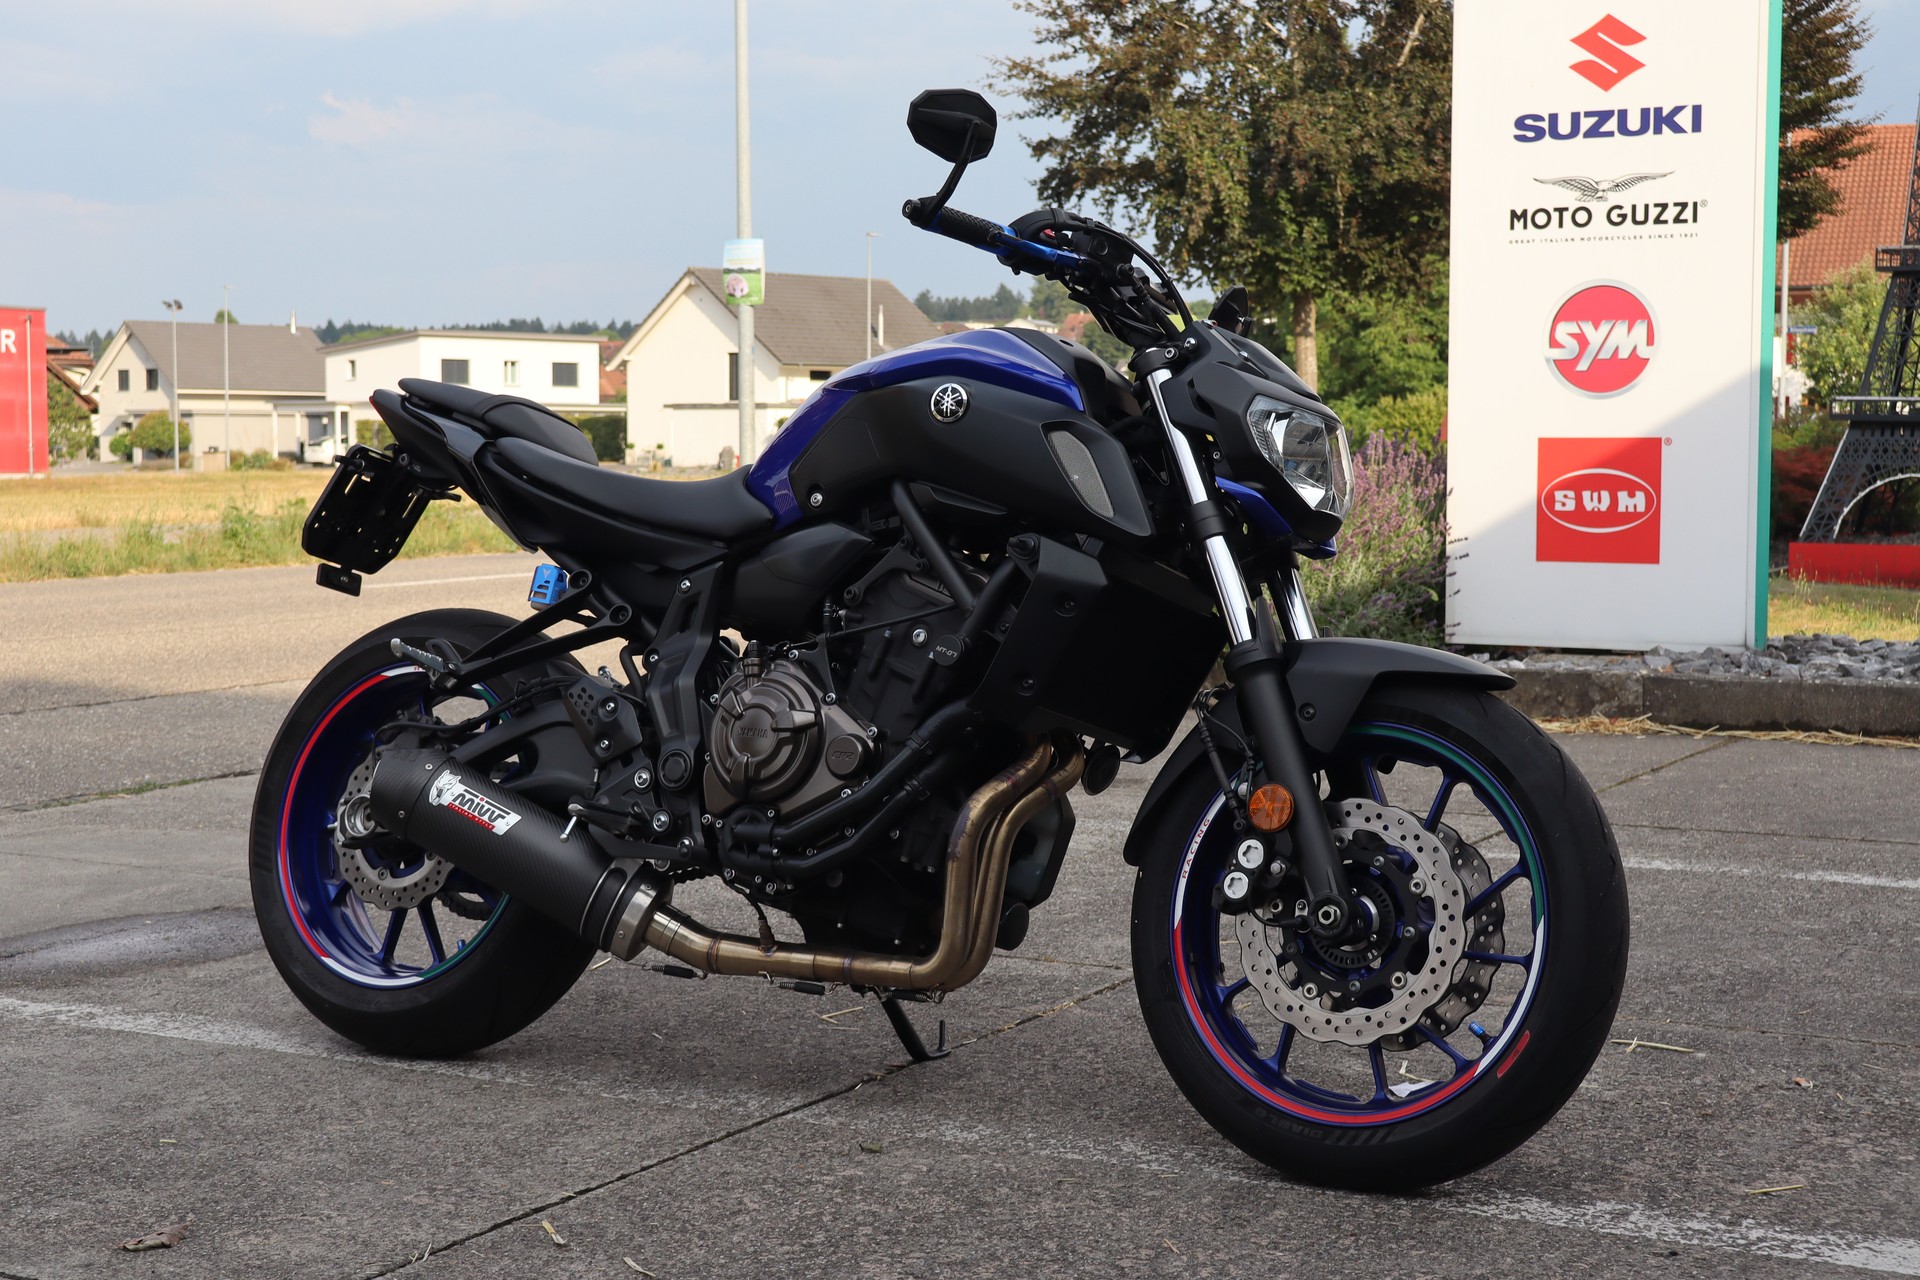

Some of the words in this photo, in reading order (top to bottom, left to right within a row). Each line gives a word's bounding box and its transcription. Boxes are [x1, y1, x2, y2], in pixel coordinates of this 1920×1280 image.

[1513, 104, 1702, 143] SUZUKI
[1509, 205, 1592, 231] MOTO
[1580, 234, 1643, 242] MOTORCYCLES
[1545, 319, 1655, 372] SYM
[1554, 490, 1646, 513] SWM
[935, 645, 958, 658] MT-07
[1182, 818, 1210, 879] RACING
